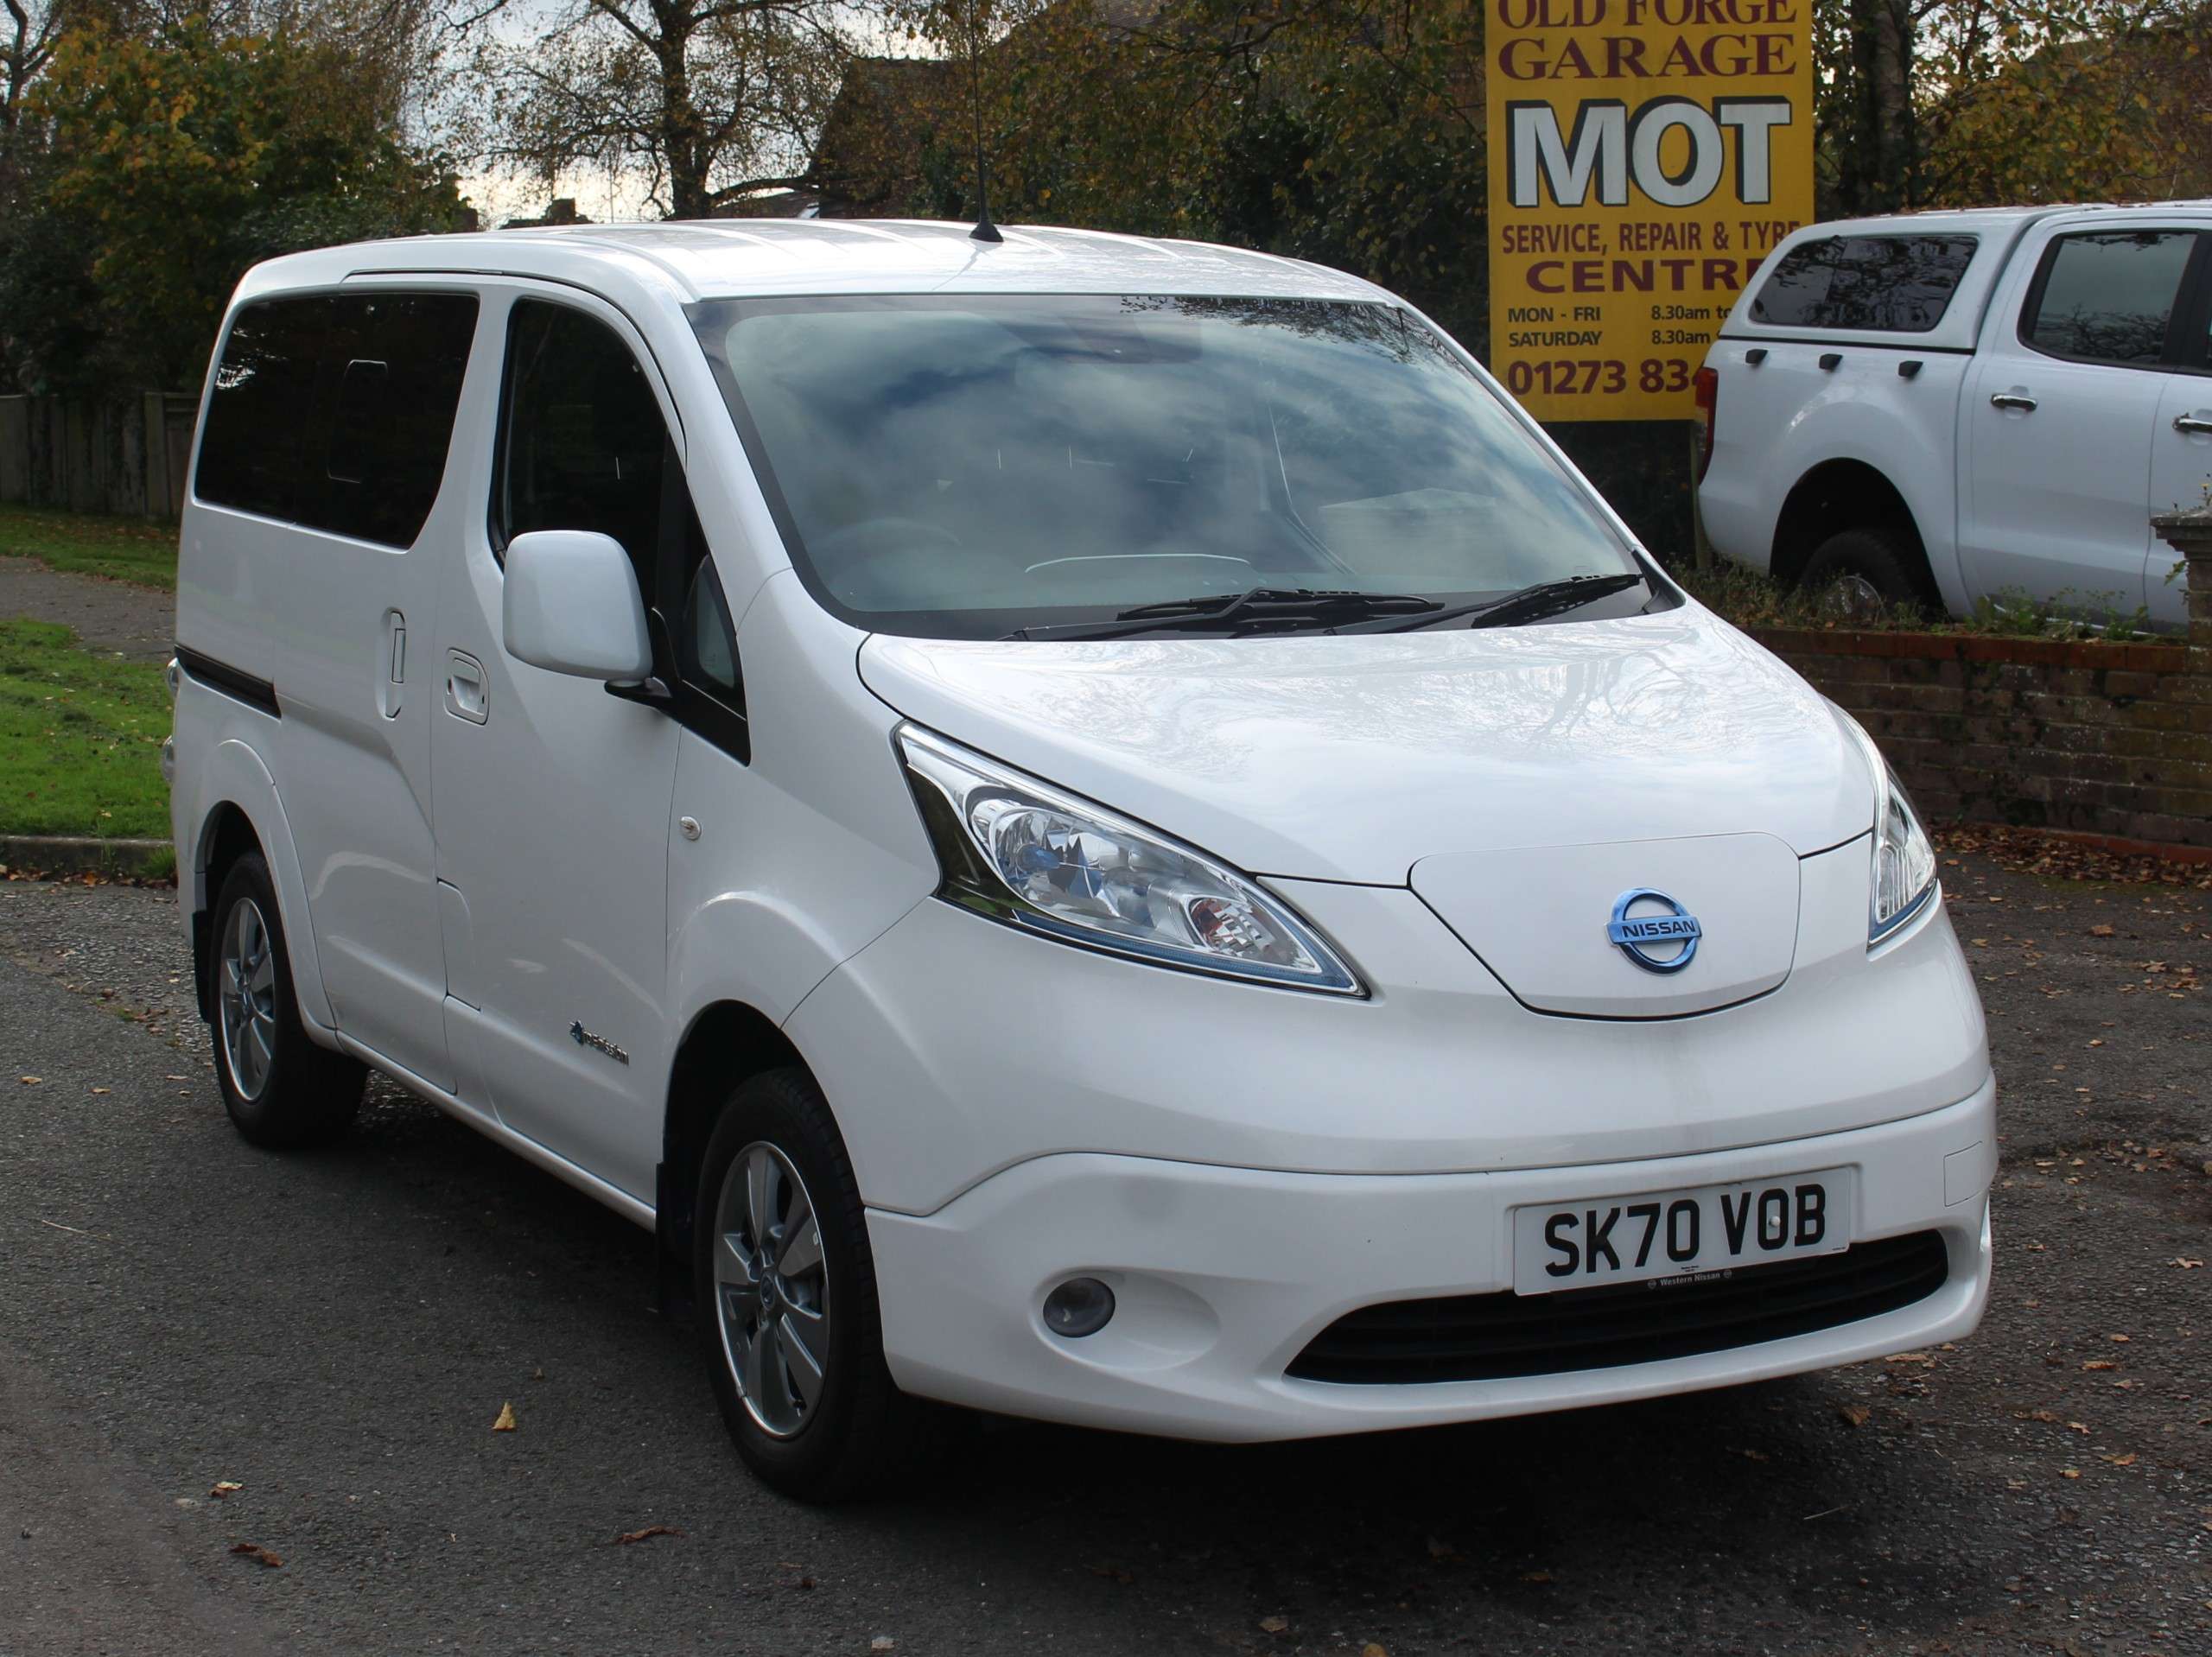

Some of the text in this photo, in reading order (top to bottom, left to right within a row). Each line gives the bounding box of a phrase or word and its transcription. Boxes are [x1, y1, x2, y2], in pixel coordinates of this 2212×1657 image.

[1498, 0, 1796, 29] OLD FORGE
[1498, 35, 1796, 80] GARAGE
[1505, 95, 1792, 208] MOT
[1503, 221, 1800, 256] SERVICE, REPAIR & TYR
[1508, 308, 1554, 322] MON
[1573, 307, 1600, 321] FRI
[1651, 305, 1710, 320] 8.30am
[1509, 331, 1602, 347] SATURDAY
[1652, 329, 1711, 345] 8.30am
[1508, 359, 1700, 396] 01273 83
[1622, 921, 1696, 938] NISSAN
[1544, 1184, 1826, 1277] SK70 VOB
[1660, 1272, 1720, 1286] Western Nissan
